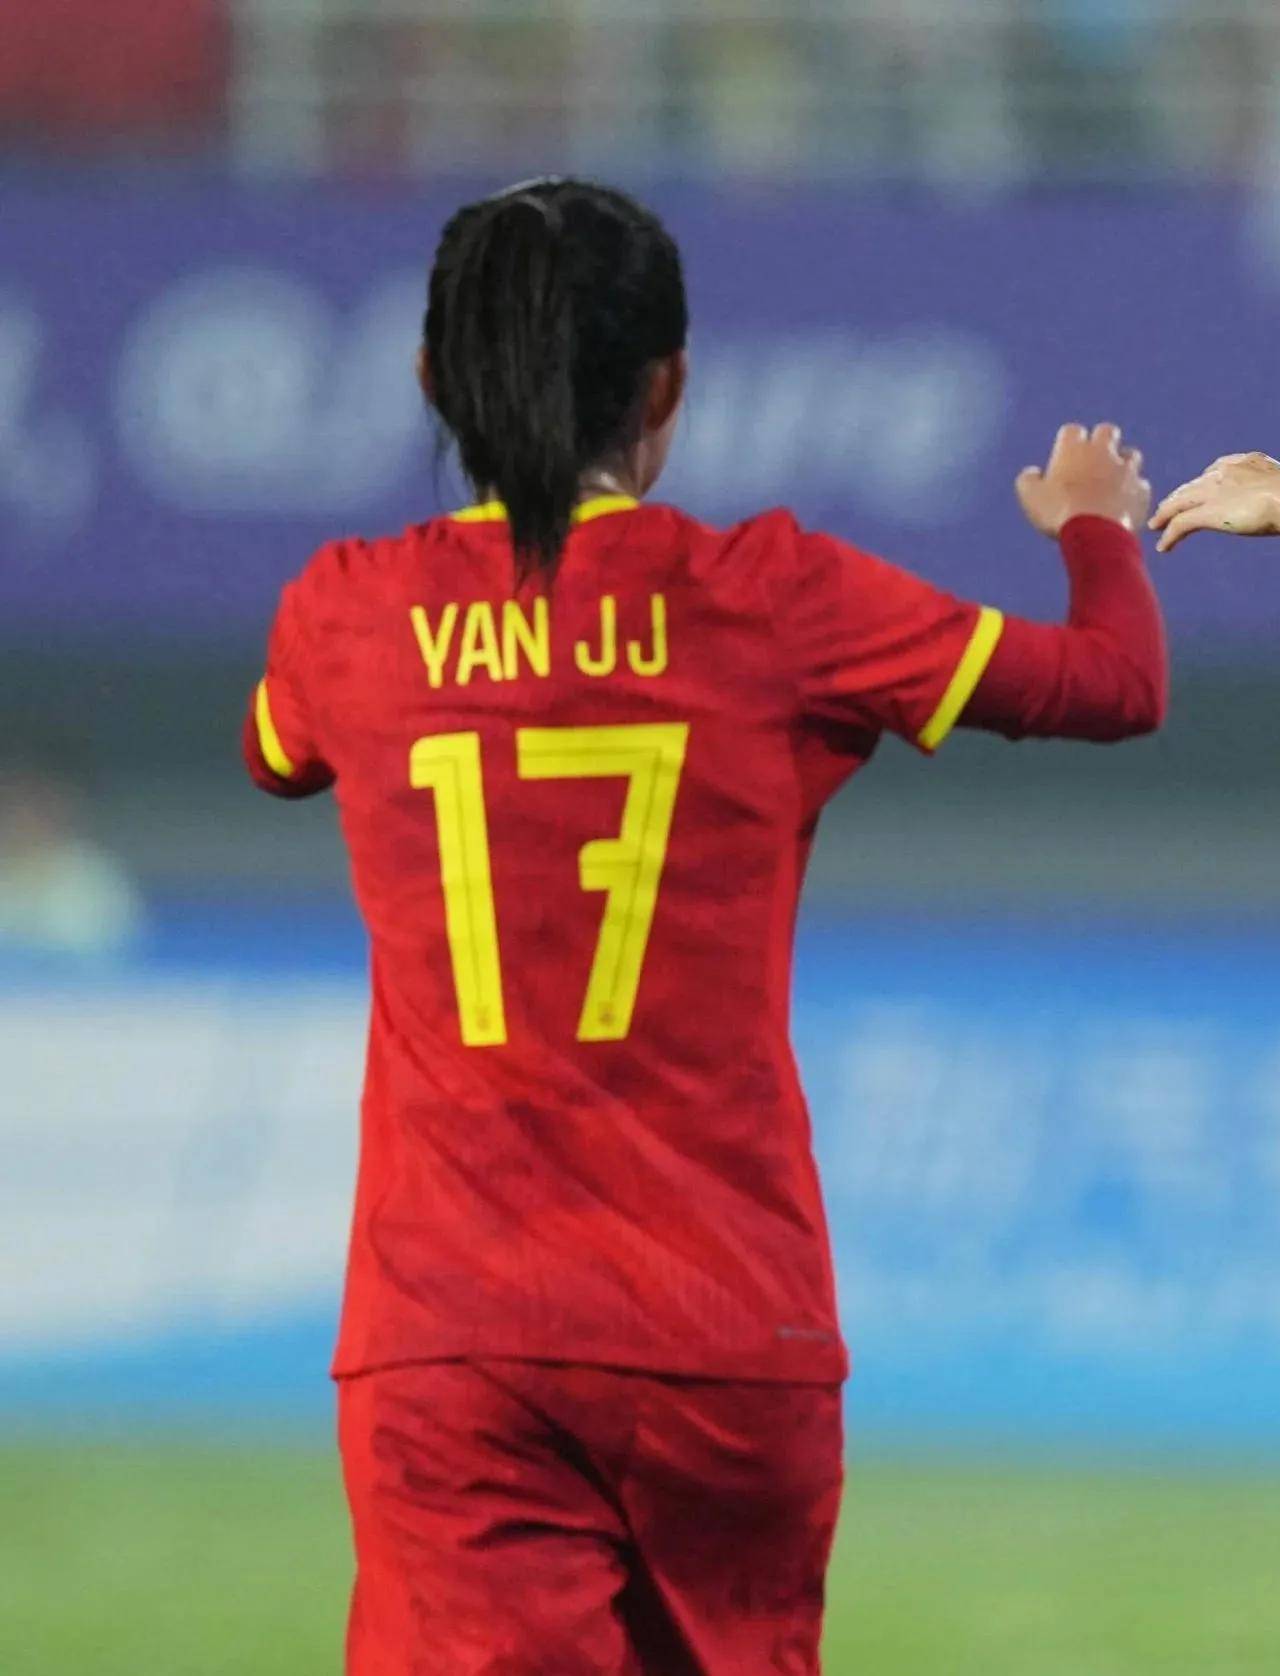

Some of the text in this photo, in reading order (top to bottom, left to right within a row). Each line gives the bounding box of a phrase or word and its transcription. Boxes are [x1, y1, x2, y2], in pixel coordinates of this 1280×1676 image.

[410, 593, 668, 688] YAN JJ
[409, 722, 690, 1047] 17
